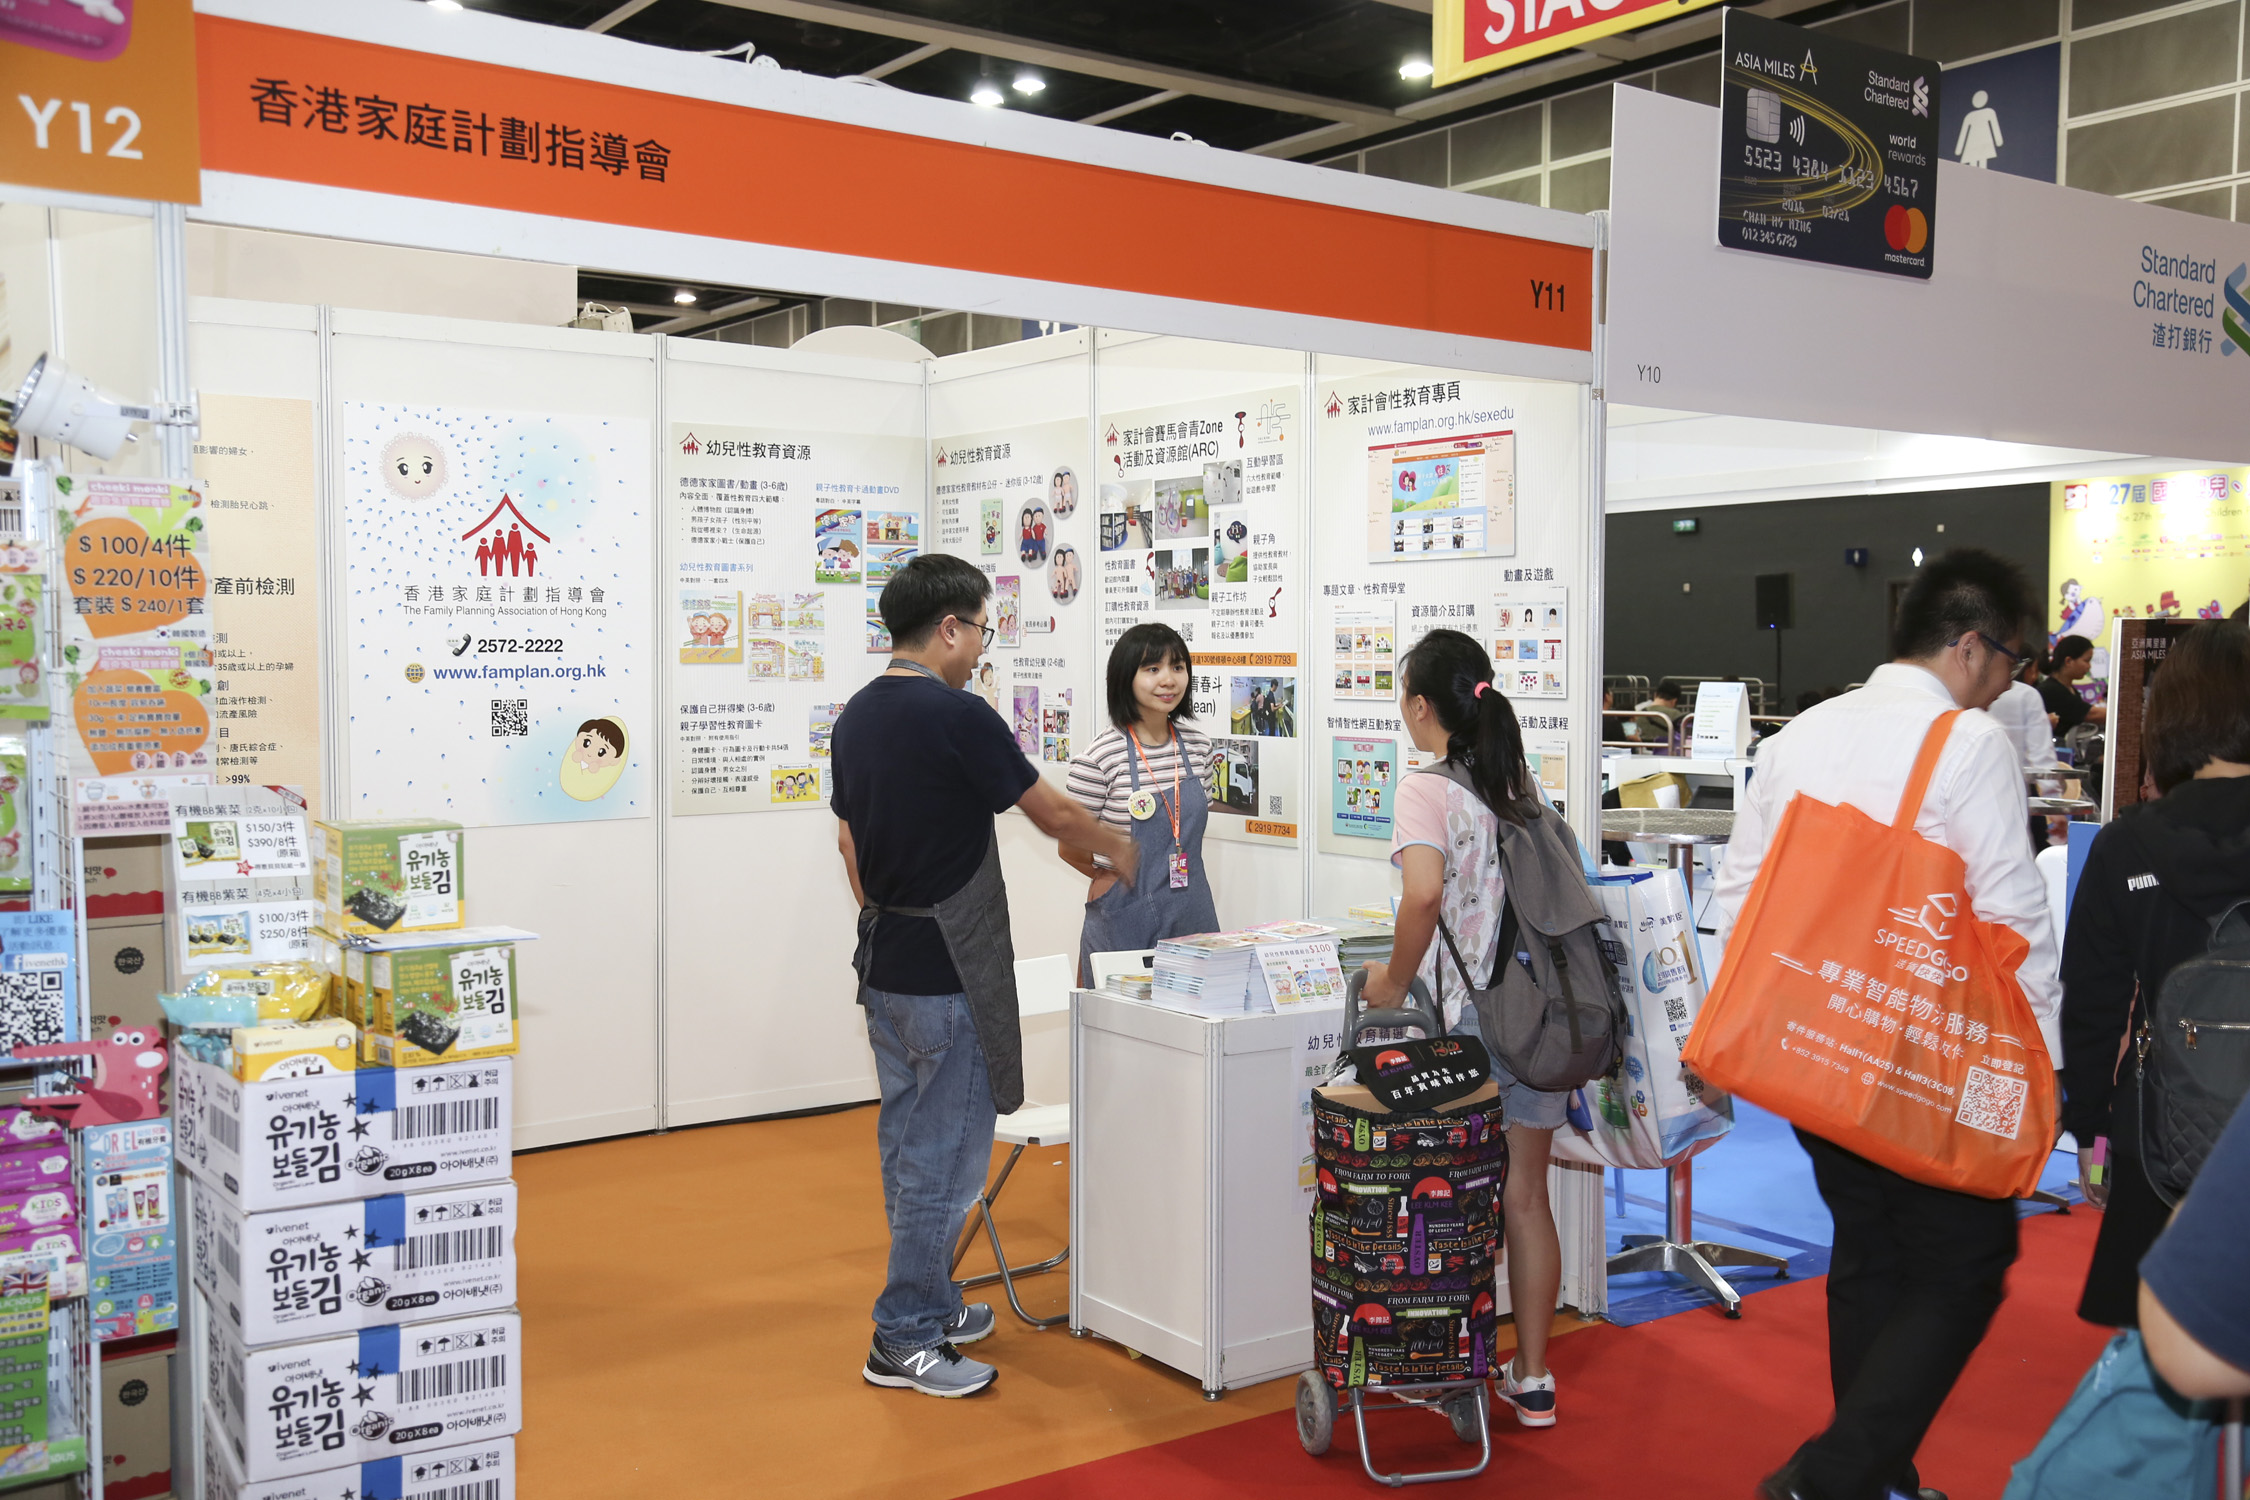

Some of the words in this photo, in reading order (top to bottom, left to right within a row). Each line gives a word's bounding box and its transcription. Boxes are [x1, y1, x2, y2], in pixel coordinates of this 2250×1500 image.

[1735, 52, 1761, 71] ASIA
[1764, 60, 1796, 80] MILES
[1868, 70, 1910, 93] Standard
[1864, 87, 1909, 111] Chartered
[18, 94, 144, 160] Y12
[250, 77, 671, 183] 香港家庭計劃指導會
[1889, 134, 1917, 149] world
[1888, 149, 1927, 167] rewards
[1744, 145, 1782, 173] 5523
[1792, 155, 1829, 181] 4384
[1884, 174, 1918, 198] 4567
[1884, 252, 1926, 267] mastercard
[2141, 246, 2215, 284] Standard
[1530, 279, 1566, 314] Y11
[2134, 280, 2214, 318] Chartered
[2153, 323, 2212, 354] 渣打銀行
[1637, 364, 1662, 385] Y10
[1348, 380, 1461, 415] 家計會性教育專頁
[1368, 406, 1514, 436] www.famplan.org.hk/sexedu
[1123, 420, 1223, 446] 家計會賽馬會青Zone
[706, 441, 811, 460] 幼兒性教育資源
[950, 443, 1011, 465] 幼兒性教育資源
[1123, 440, 1219, 468] 活動及資源館(ARC)
[91, 482, 130, 492] cheeki
[133, 484, 169, 494] monki
[79, 536, 92, 552] $
[100, 534, 191, 558] 100/4件
[74, 568, 86, 585] $
[93, 565, 199, 590] 220/10件
[1504, 567, 1554, 582] 動畫及遊戲
[214, 577, 295, 596] 產前檢測
[404, 584, 605, 604] 香港家庭計劃指導會
[73, 596, 115, 615] 套裝
[121, 597, 132, 612] $
[137, 597, 204, 615] 240/1套
[403, 605, 421, 616] The
[423, 605, 453, 617] Family
[456, 606, 494, 617] Planning
[497, 606, 547, 616] Association
[550, 606, 558, 616] of
[559, 606, 582, 618] Hong
[585, 606, 607, 618] Kong
[1411, 604, 1475, 617] 資源簡介及訂購
[477, 639, 563, 653] 2572-2222
[2131, 650, 2147, 660] ASIA
[2149, 650, 2166, 660] MILES
[1256, 655, 1272, 664] 2919
[1274, 655, 1291, 664] 7793
[433, 664, 606, 682] www.famplan.org.hk
[175, 805, 241, 816] 有機BB紫菜
[246, 821, 295, 832] $150/3件
[1255, 822, 1272, 834] 2919
[1273, 824, 1290, 836] 7734
[248, 836, 297, 847] $390/8件
[407, 849, 450, 872] 유기농
[410, 869, 451, 894] 보들김
[2127, 874, 2160, 892] PUM
[182, 888, 249, 902] 有機BB紫菜
[259, 910, 309, 923] $100/3件
[1309, 944, 1331, 953] $100
[458, 966, 503, 991] 유기농
[463, 988, 505, 1014] 보들김
[1792, 1046, 1810, 1060] +852
[1811, 1052, 1830, 1067] 3915
[1831, 1061, 1850, 1074] 7348
[1839, 1043, 1895, 1073] Hall1(AA25)
[1895, 1067, 1902, 1076] &
[1980, 1053, 2026, 1075] 立即登記
[273, 1088, 308, 1100] ivenet
[1390, 1068, 1480, 1100] 百年真味陪伴您
[1877, 1079, 1952, 1114] www.speedgogo.com
[266, 1109, 341, 1150] 유기농
[272, 1142, 341, 1184] 보들김
[345, 1153, 390, 1171] Organic
[440, 1155, 498, 1171] 아이배냇(주)
[1334, 1168, 1352, 1177] FROM
[1353, 1172, 1374, 1180] FARM
[1388, 1172, 1411, 1180] FORK
[1348, 1184, 1388, 1194] INNOVATION
[1430, 1189, 1450, 1198] 李錦記
[274, 1221, 309, 1233] ivenet
[266, 1242, 341, 1283] 유기농
[273, 1274, 341, 1316] 보들김
[345, 1284, 391, 1302] Organic
[443, 1283, 503, 1300] 아이배냇(주)
[1413, 1296, 1433, 1304] FARM
[1449, 1294, 1470, 1302] FORK
[269, 1378, 344, 1421] 유기농
[275, 1409, 345, 1451] 보들김
[350, 1416, 394, 1436] Organic
